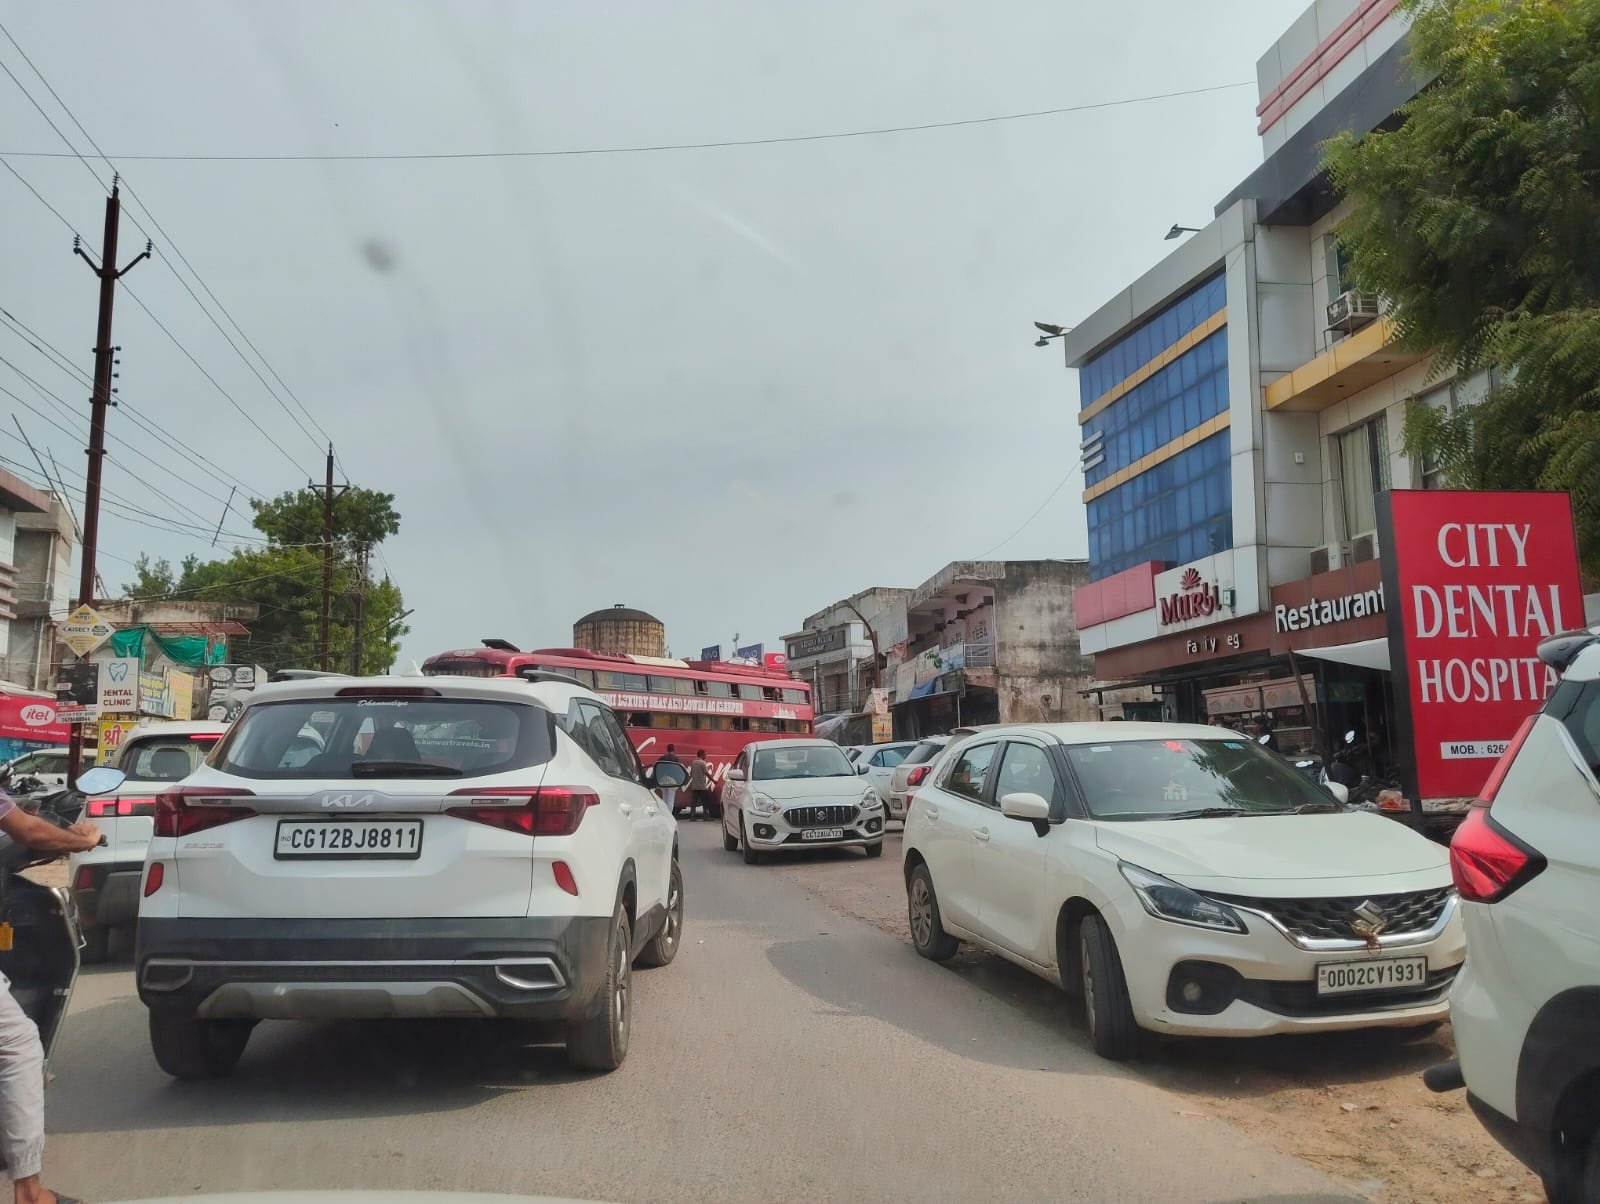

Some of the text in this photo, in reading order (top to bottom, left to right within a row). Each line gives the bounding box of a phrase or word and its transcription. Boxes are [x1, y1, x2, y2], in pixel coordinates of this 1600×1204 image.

[1437, 523, 1531, 568] CITY
[1275, 582, 1385, 634] Restaurant
[1411, 585, 1574, 638] DENTAL
[1417, 658, 1560, 703] HOSPITA
[26, 708, 50, 721] itel
[1450, 744, 1478, 755] MOB.
[291, 828, 416, 850] CG12BJ8811
[1328, 963, 1423, 988] OD02CV1931
